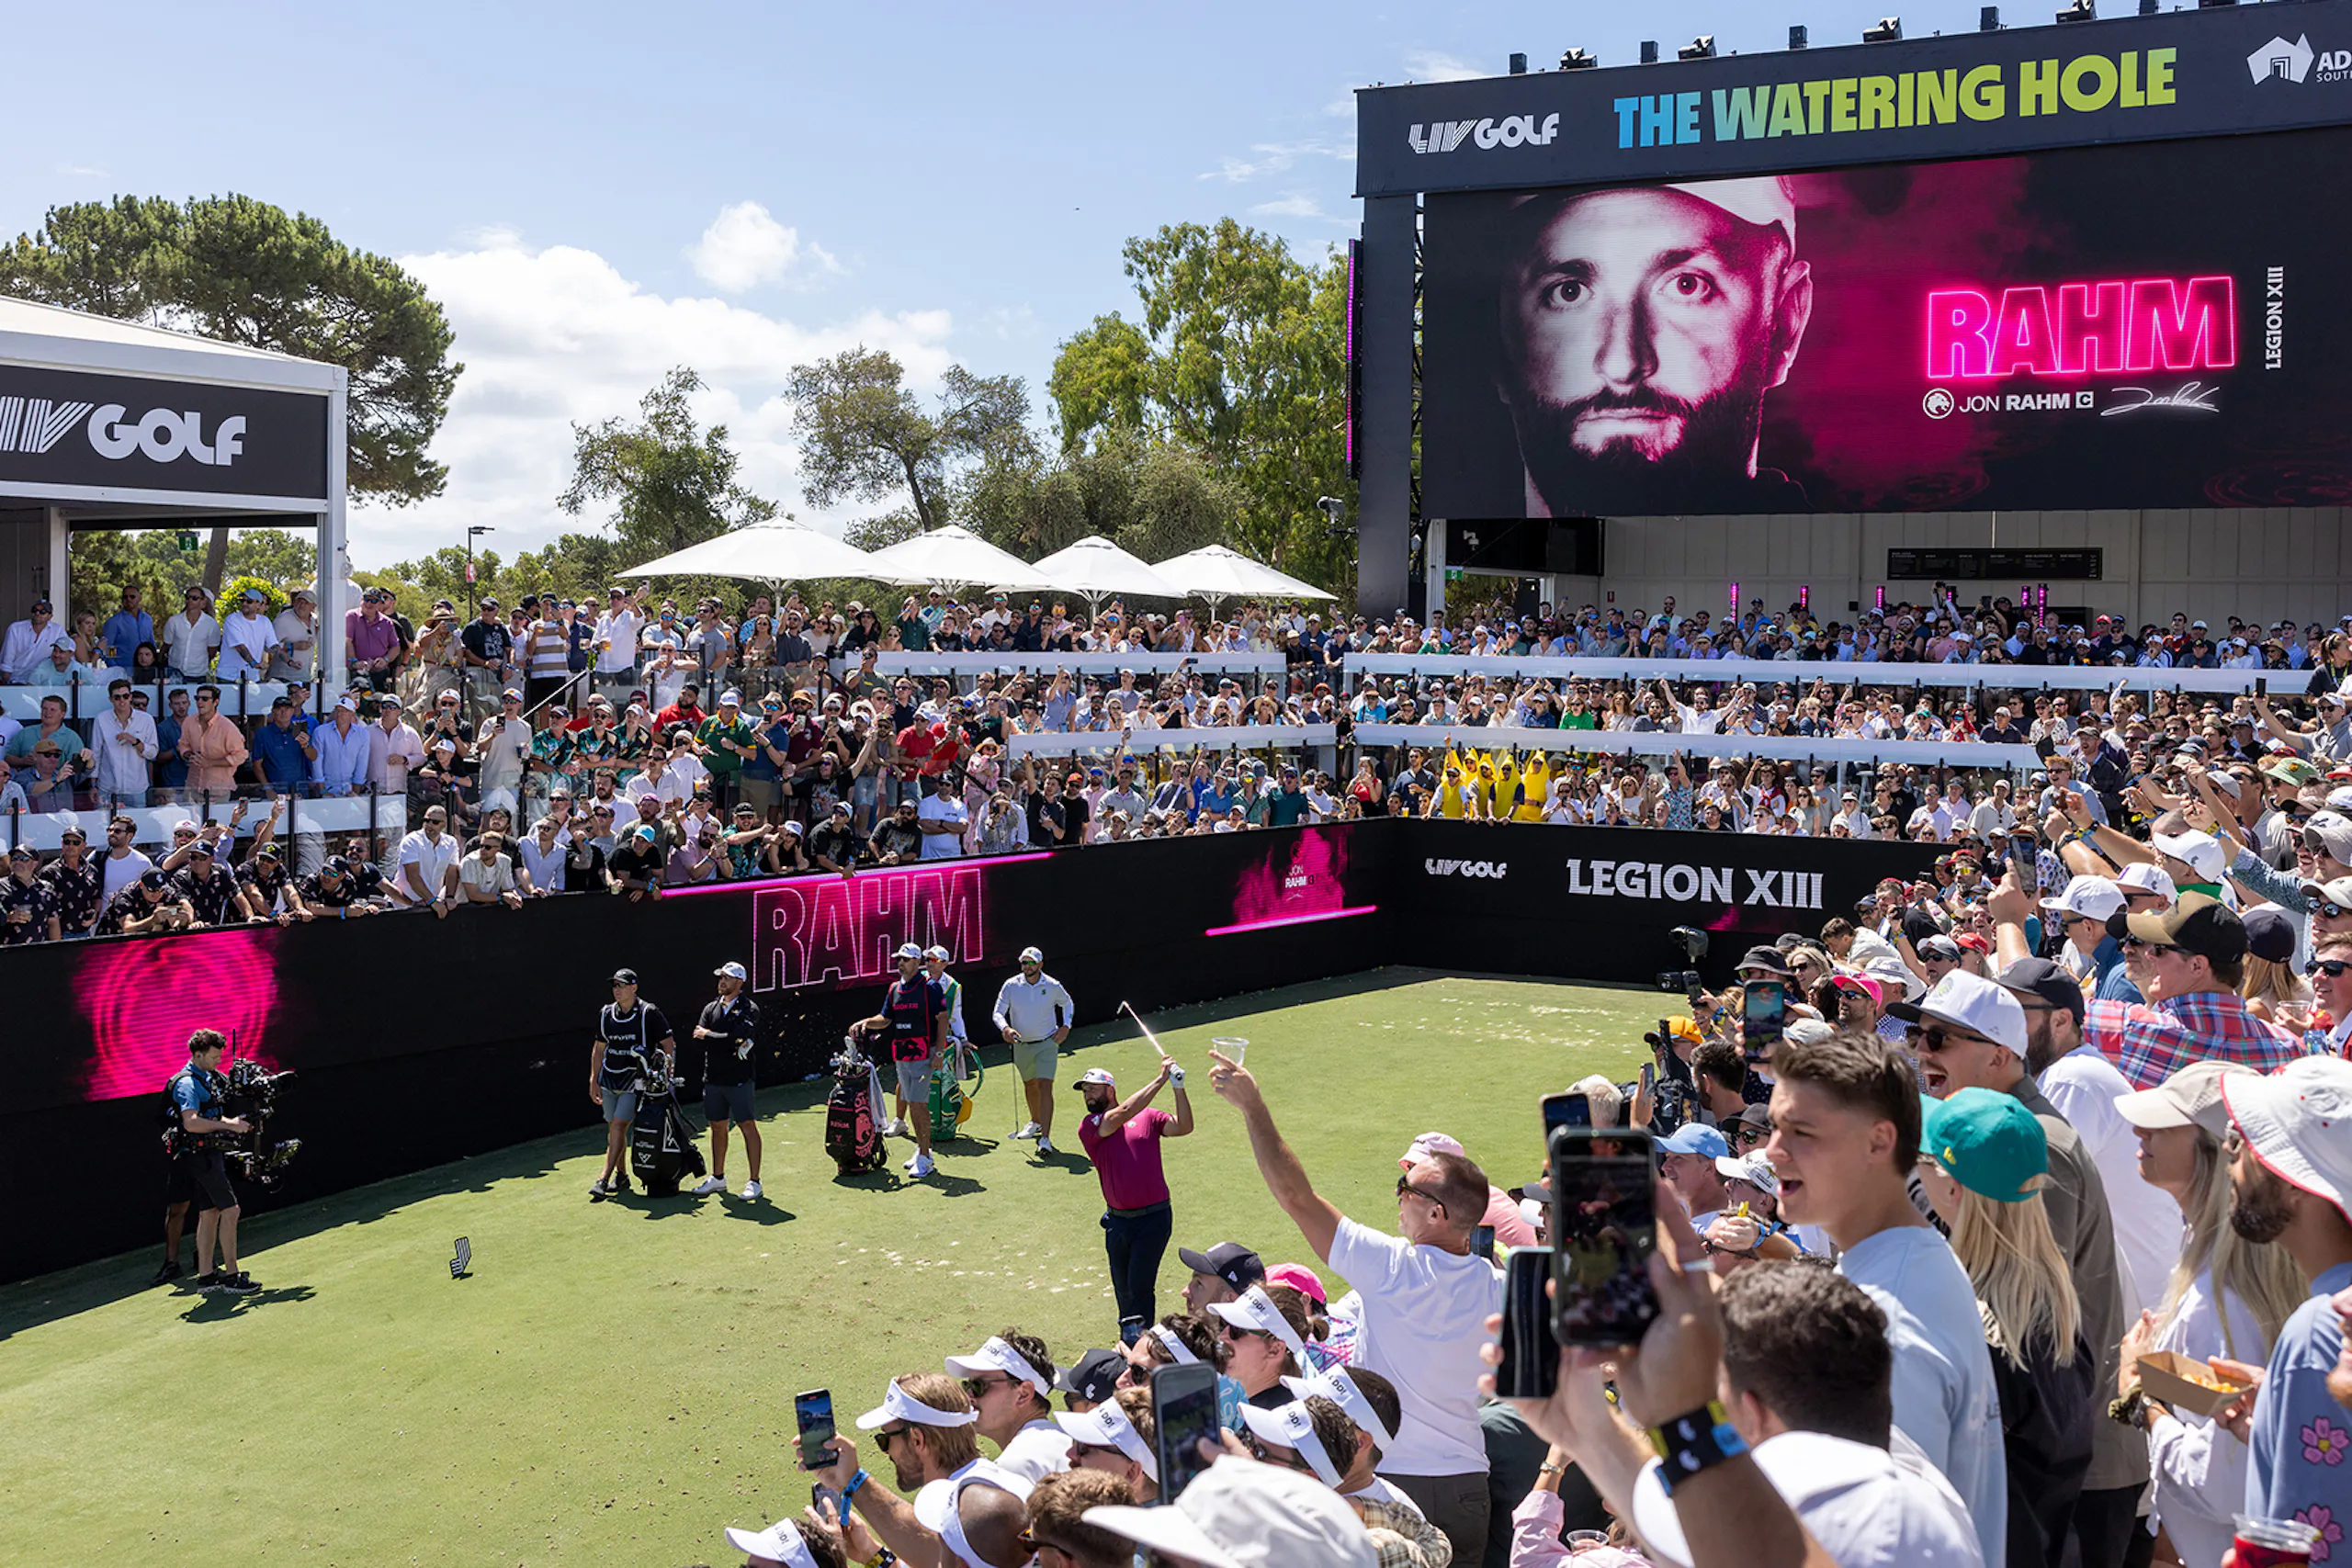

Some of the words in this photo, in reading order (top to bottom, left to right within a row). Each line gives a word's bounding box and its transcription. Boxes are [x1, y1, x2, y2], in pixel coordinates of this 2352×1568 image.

[2316, 51, 2352, 72] AD
[2316, 70, 2352, 84] SOUT
[1613, 91, 1702, 149] THE
[1711, 64, 2006, 141] WATERING
[2018, 47, 2177, 118] HOLE
[1408, 119, 1477, 154] LIV
[1473, 113, 1560, 151] GOLF
[2267, 265, 2284, 299] XIII
[1928, 276, 2235, 379] RAHM
[2265, 300, 2283, 370] LEGION
[1958, 395, 2000, 413] JON
[2005, 392, 2071, 412] RAHM
[0, 396, 95, 454] IV
[87, 403, 247, 466] GOLF
[1284, 875, 1306, 888] RAHM
[1288, 864, 1304, 876] JON
[1425, 857, 1463, 875] LIV
[1460, 860, 1507, 879] GOLF
[1566, 859, 1736, 905] LEGION
[1743, 868, 1825, 909] XIII
[752, 869, 983, 993] RAHM
[1331, 1379, 1347, 1395] DD!
